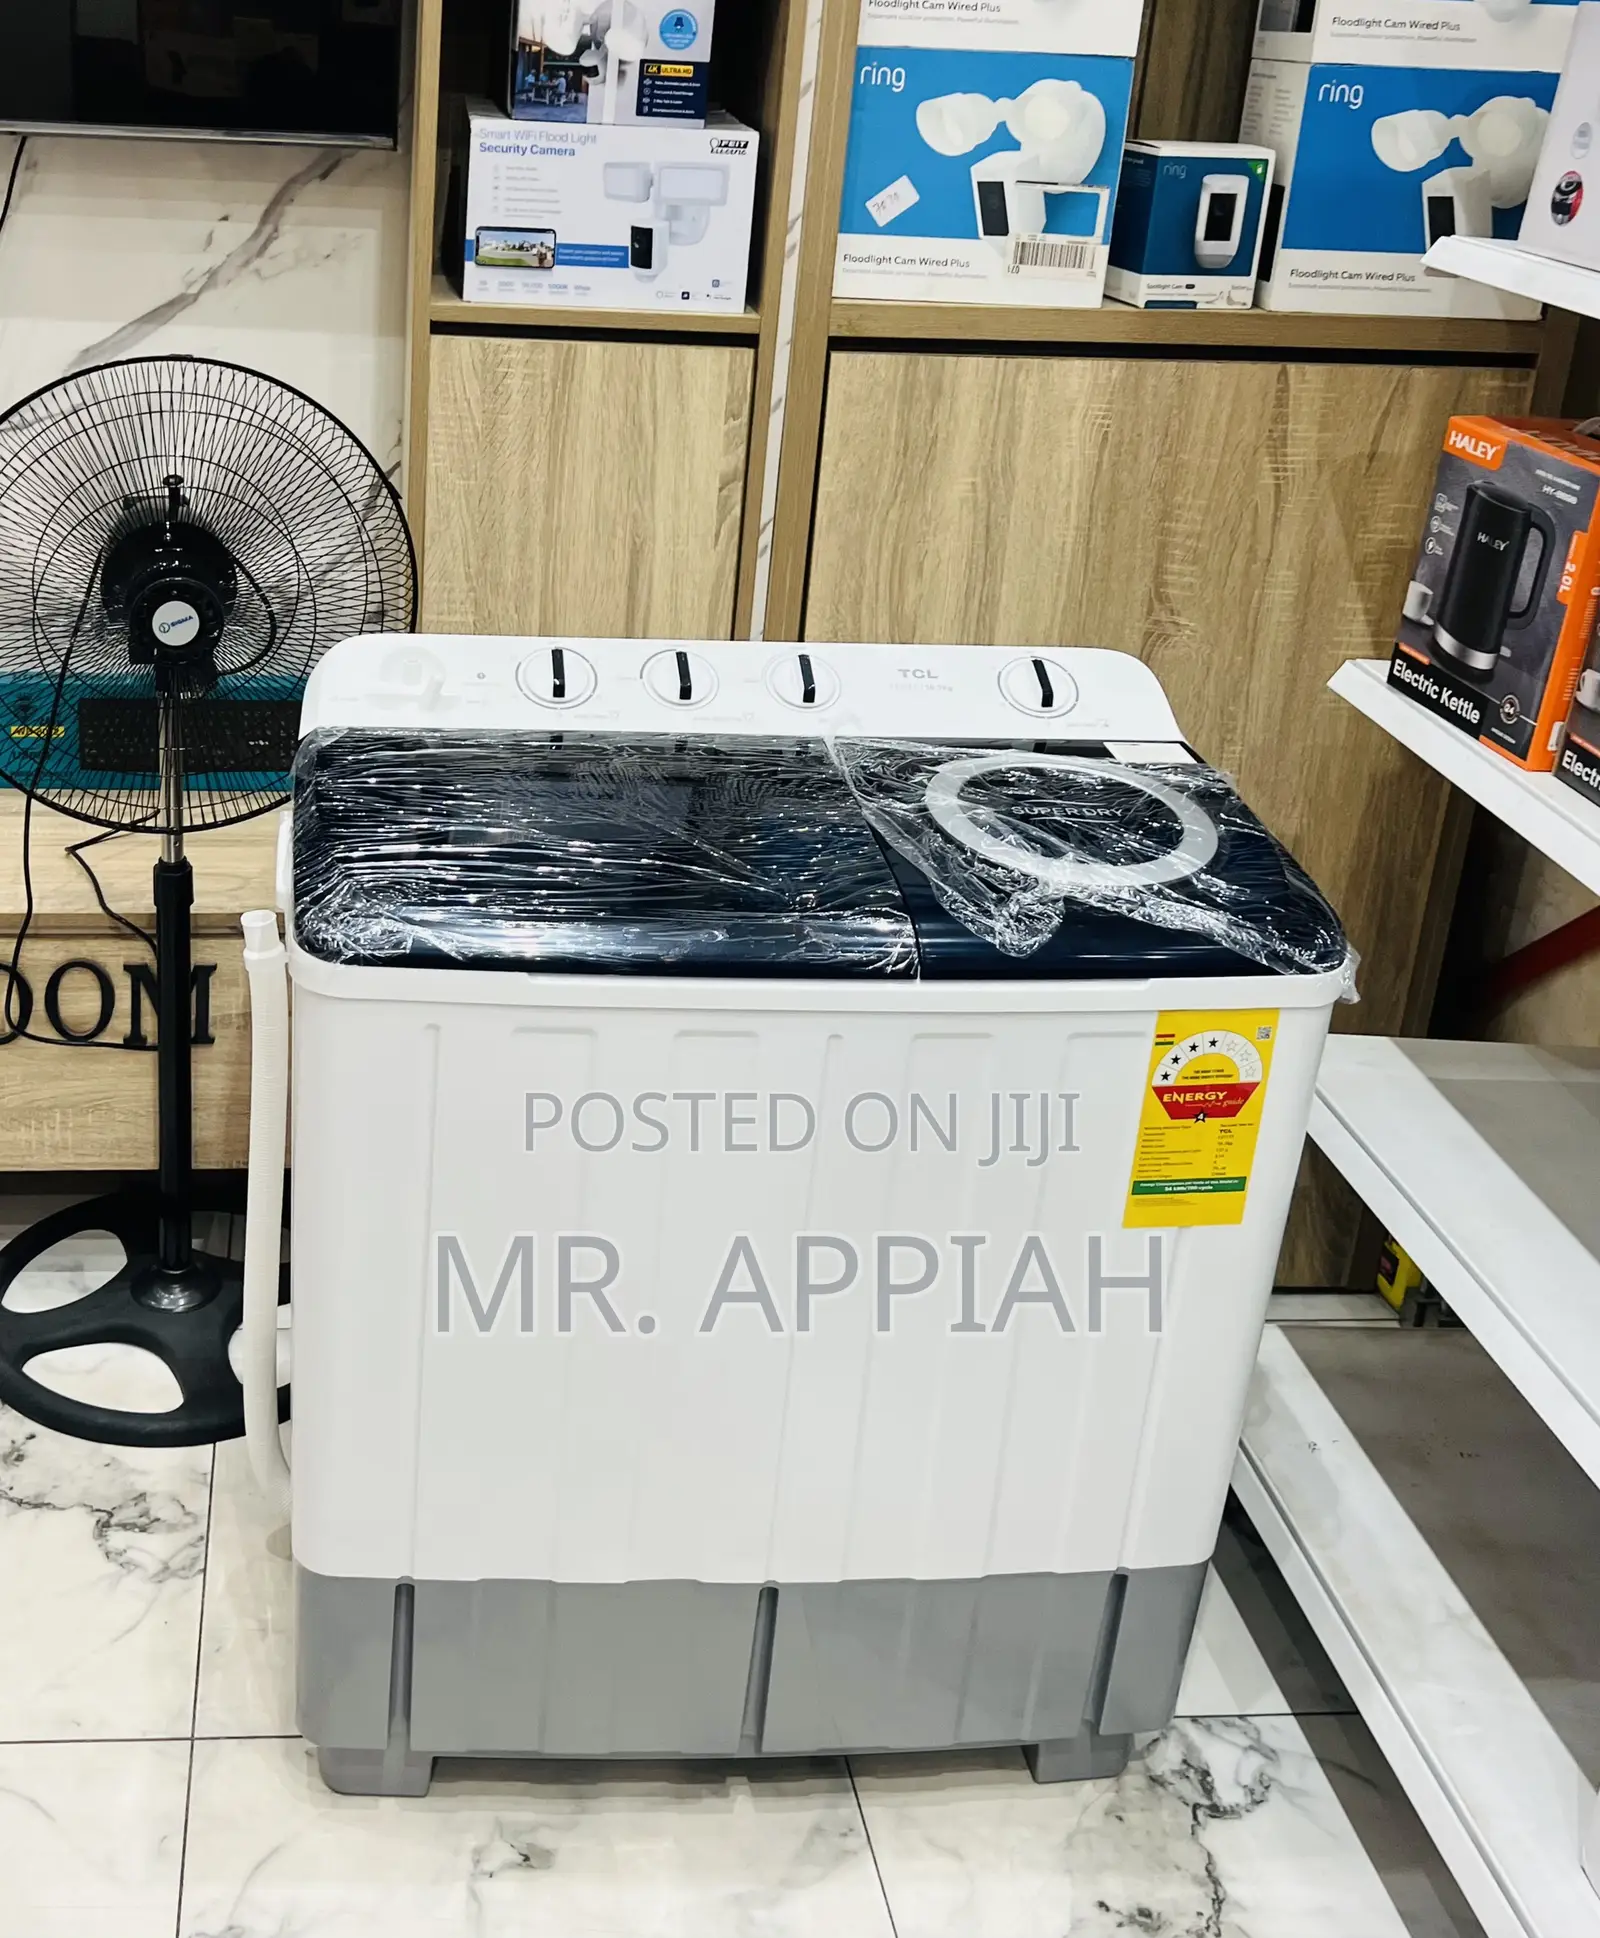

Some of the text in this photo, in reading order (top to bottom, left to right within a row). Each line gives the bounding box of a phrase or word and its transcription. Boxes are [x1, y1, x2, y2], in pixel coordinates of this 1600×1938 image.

[921, 0, 945, 10] Cam
[947, 0, 978, 11] Wired
[980, 2, 1001, 13] Plus
[1331, 16, 1461, 31] Floodlight Cam Wired Plus
[661, 65, 682, 74] ULTRA
[682, 67, 692, 75] HD
[859, 61, 906, 93] ring
[1318, 79, 1364, 109] ring
[479, 128, 597, 146] Smart WiFi Flood Light
[479, 142, 576, 157] Security Camera
[1163, 161, 1188, 179] ring
[842, 253, 971, 268] Floodlight Cam Wired Plus
[1289, 268, 1416, 282] Floodlight Cam Wired Plus
[1448, 430, 1498, 461] HALEY
[1559, 562, 1577, 593] 2.0L
[898, 668, 939, 680] TCL
[1392, 658, 1481, 724] Electric Kettle
[1561, 749, 1600, 791] Electr
[1011, 805, 1123, 817] SUPER DRY
[1162, 1090, 1228, 1104] ENERGY
